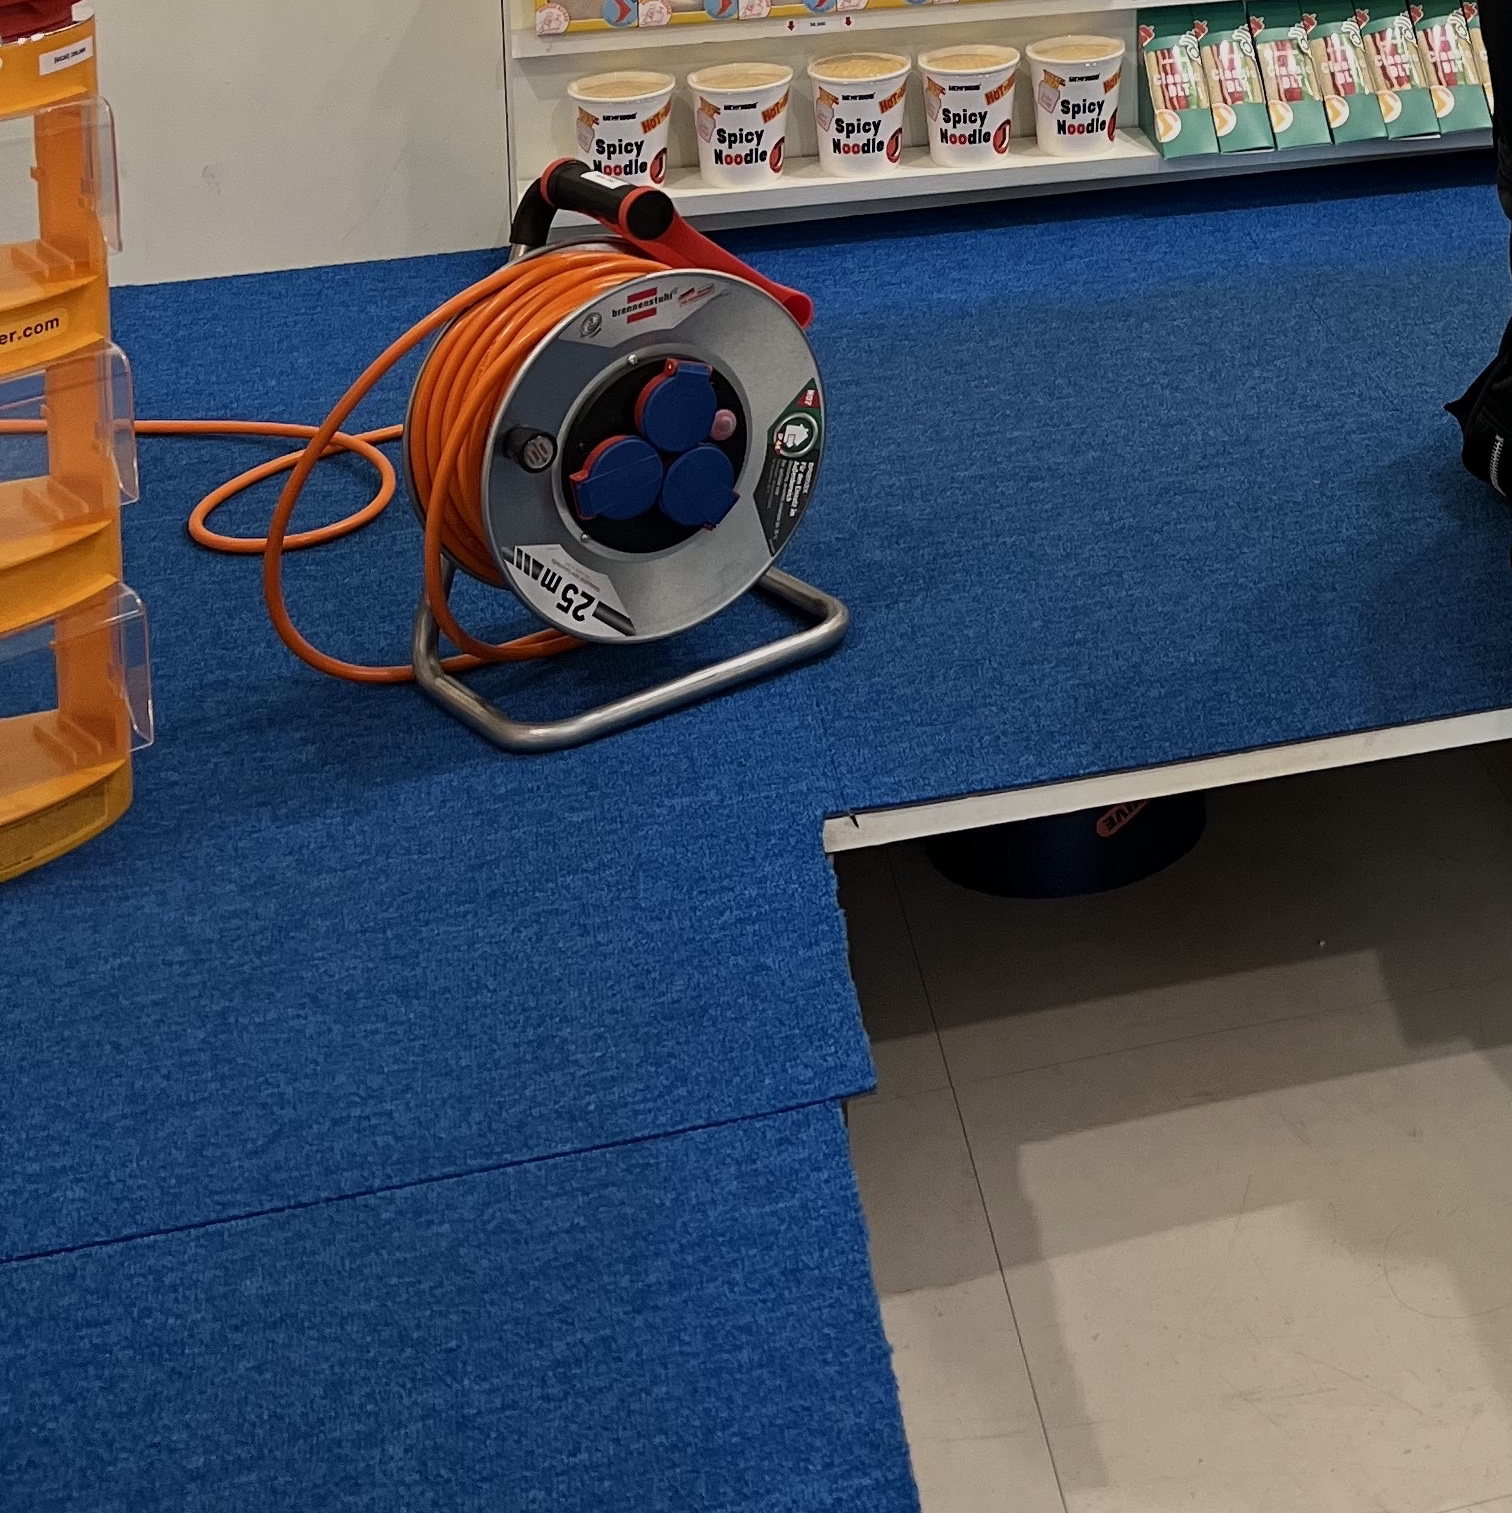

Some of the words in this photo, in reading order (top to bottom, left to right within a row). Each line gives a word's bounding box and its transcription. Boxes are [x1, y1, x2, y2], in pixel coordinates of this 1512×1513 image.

[1060, 99, 1105, 115] Spicy
[942, 108, 988, 129] Spicy
[1057, 117, 1106, 135] Noodle
[835, 118, 881, 138] Spicy
[940, 128, 991, 145] Noodle
[716, 129, 765, 148] Spicy
[832, 139, 884, 154] Noodle
[714, 149, 768, 165] Noodle
[556, 583, 596, 622] 25
